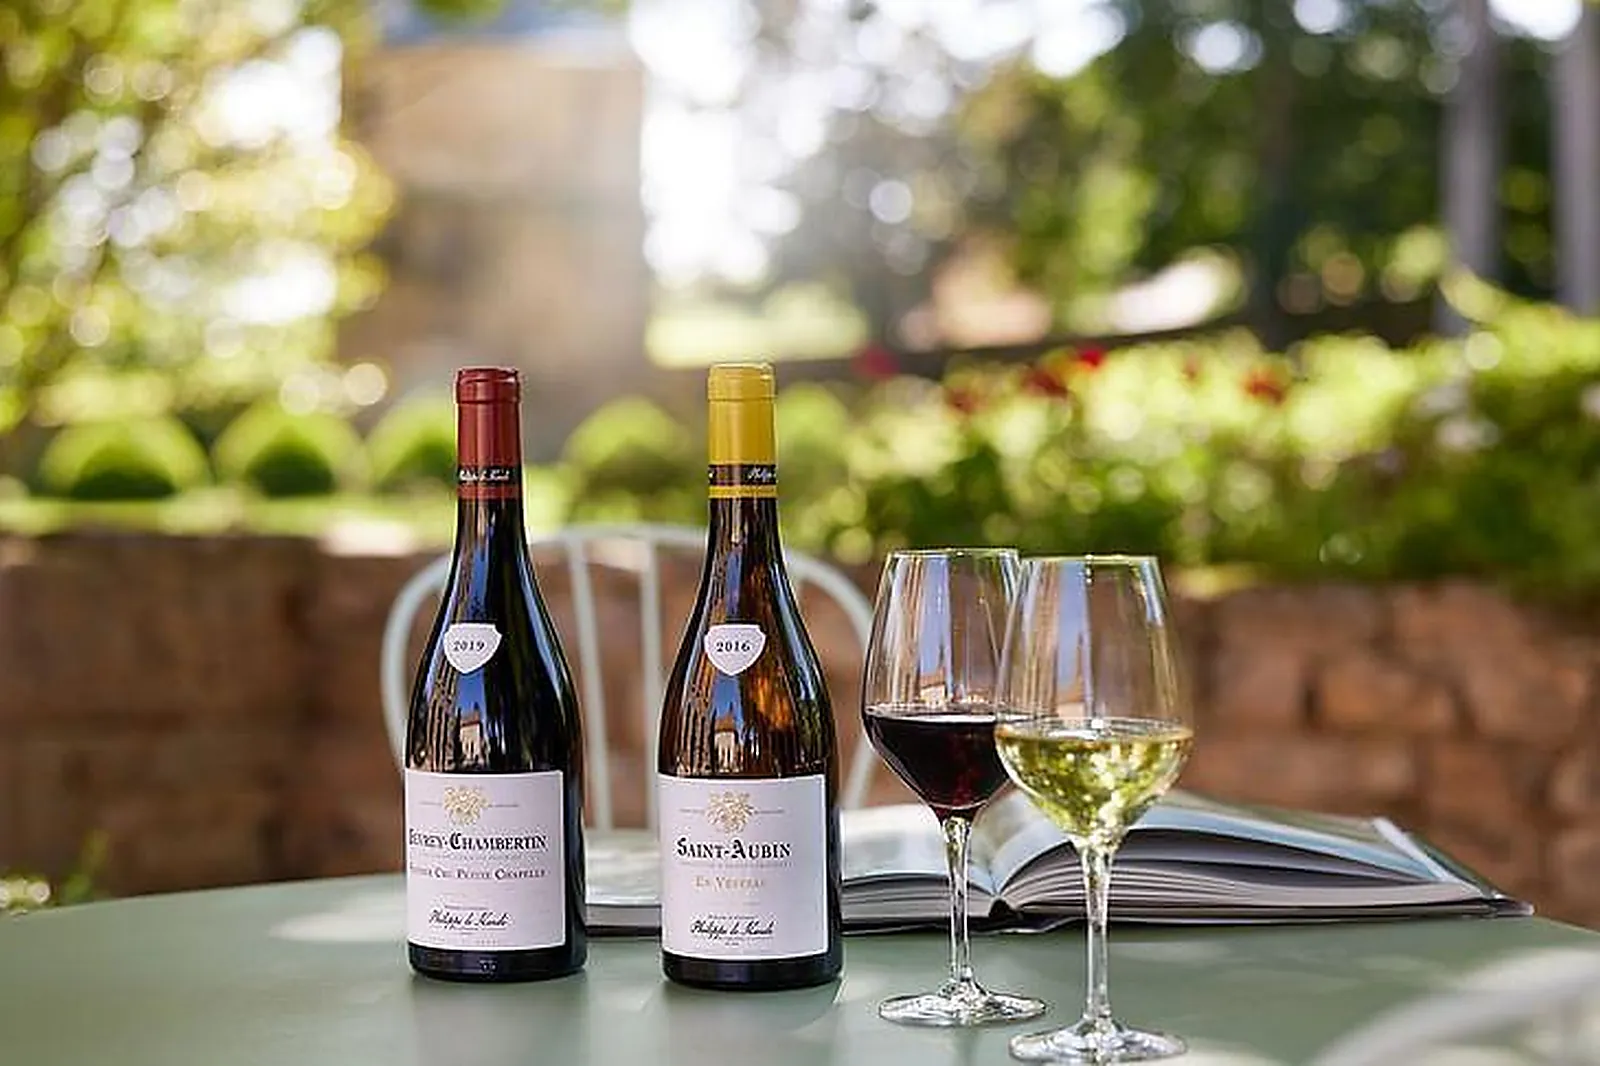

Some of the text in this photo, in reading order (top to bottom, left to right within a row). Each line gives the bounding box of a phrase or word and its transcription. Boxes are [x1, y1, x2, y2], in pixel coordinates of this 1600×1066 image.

[453, 640, 485, 652] 2019
[716, 640, 751, 652] 2016
[677, 837, 791, 859] SAINT-AUBIN
